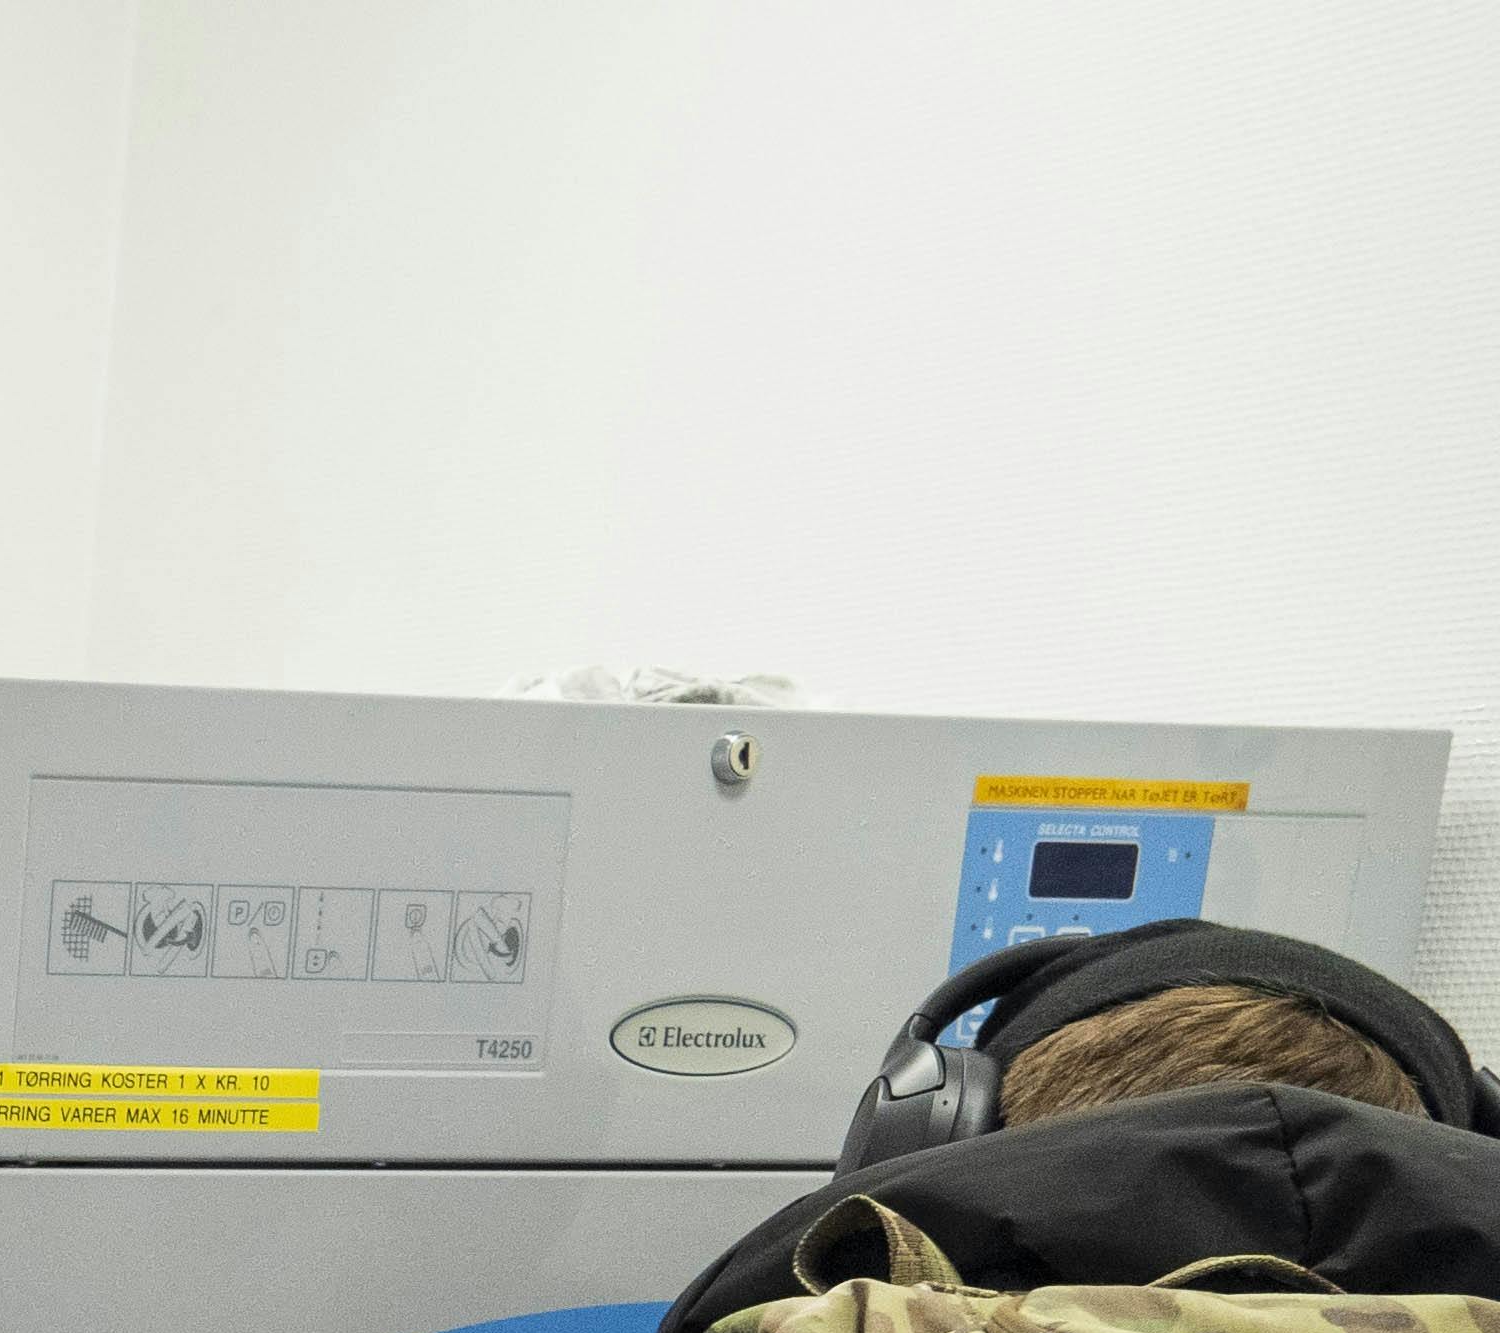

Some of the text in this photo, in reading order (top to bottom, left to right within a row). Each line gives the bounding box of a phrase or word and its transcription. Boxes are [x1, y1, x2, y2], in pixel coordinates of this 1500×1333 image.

[988, 785, 1049, 799] MASKINEN
[1053, 786, 1107, 799] STOPPER
[1183, 790, 1197, 802] ER
[663, 1026, 767, 1048] Electrolux
[476, 1039, 533, 1059] T4250
[16, 1071, 92, 1088] TØRRING
[101, 1073, 168, 1089] KOSTER
[179, 1074, 185, 1089] 1
[196, 1075, 206, 1090] X
[216, 1075, 241, 1091] KR.
[253, 1076, 270, 1091] 10
[61, 1107, 117, 1123] VARER
[126, 1107, 162, 1124] MAX
[172, 1109, 189, 1124] 16
[198, 1109, 269, 1125] MINUTTE
